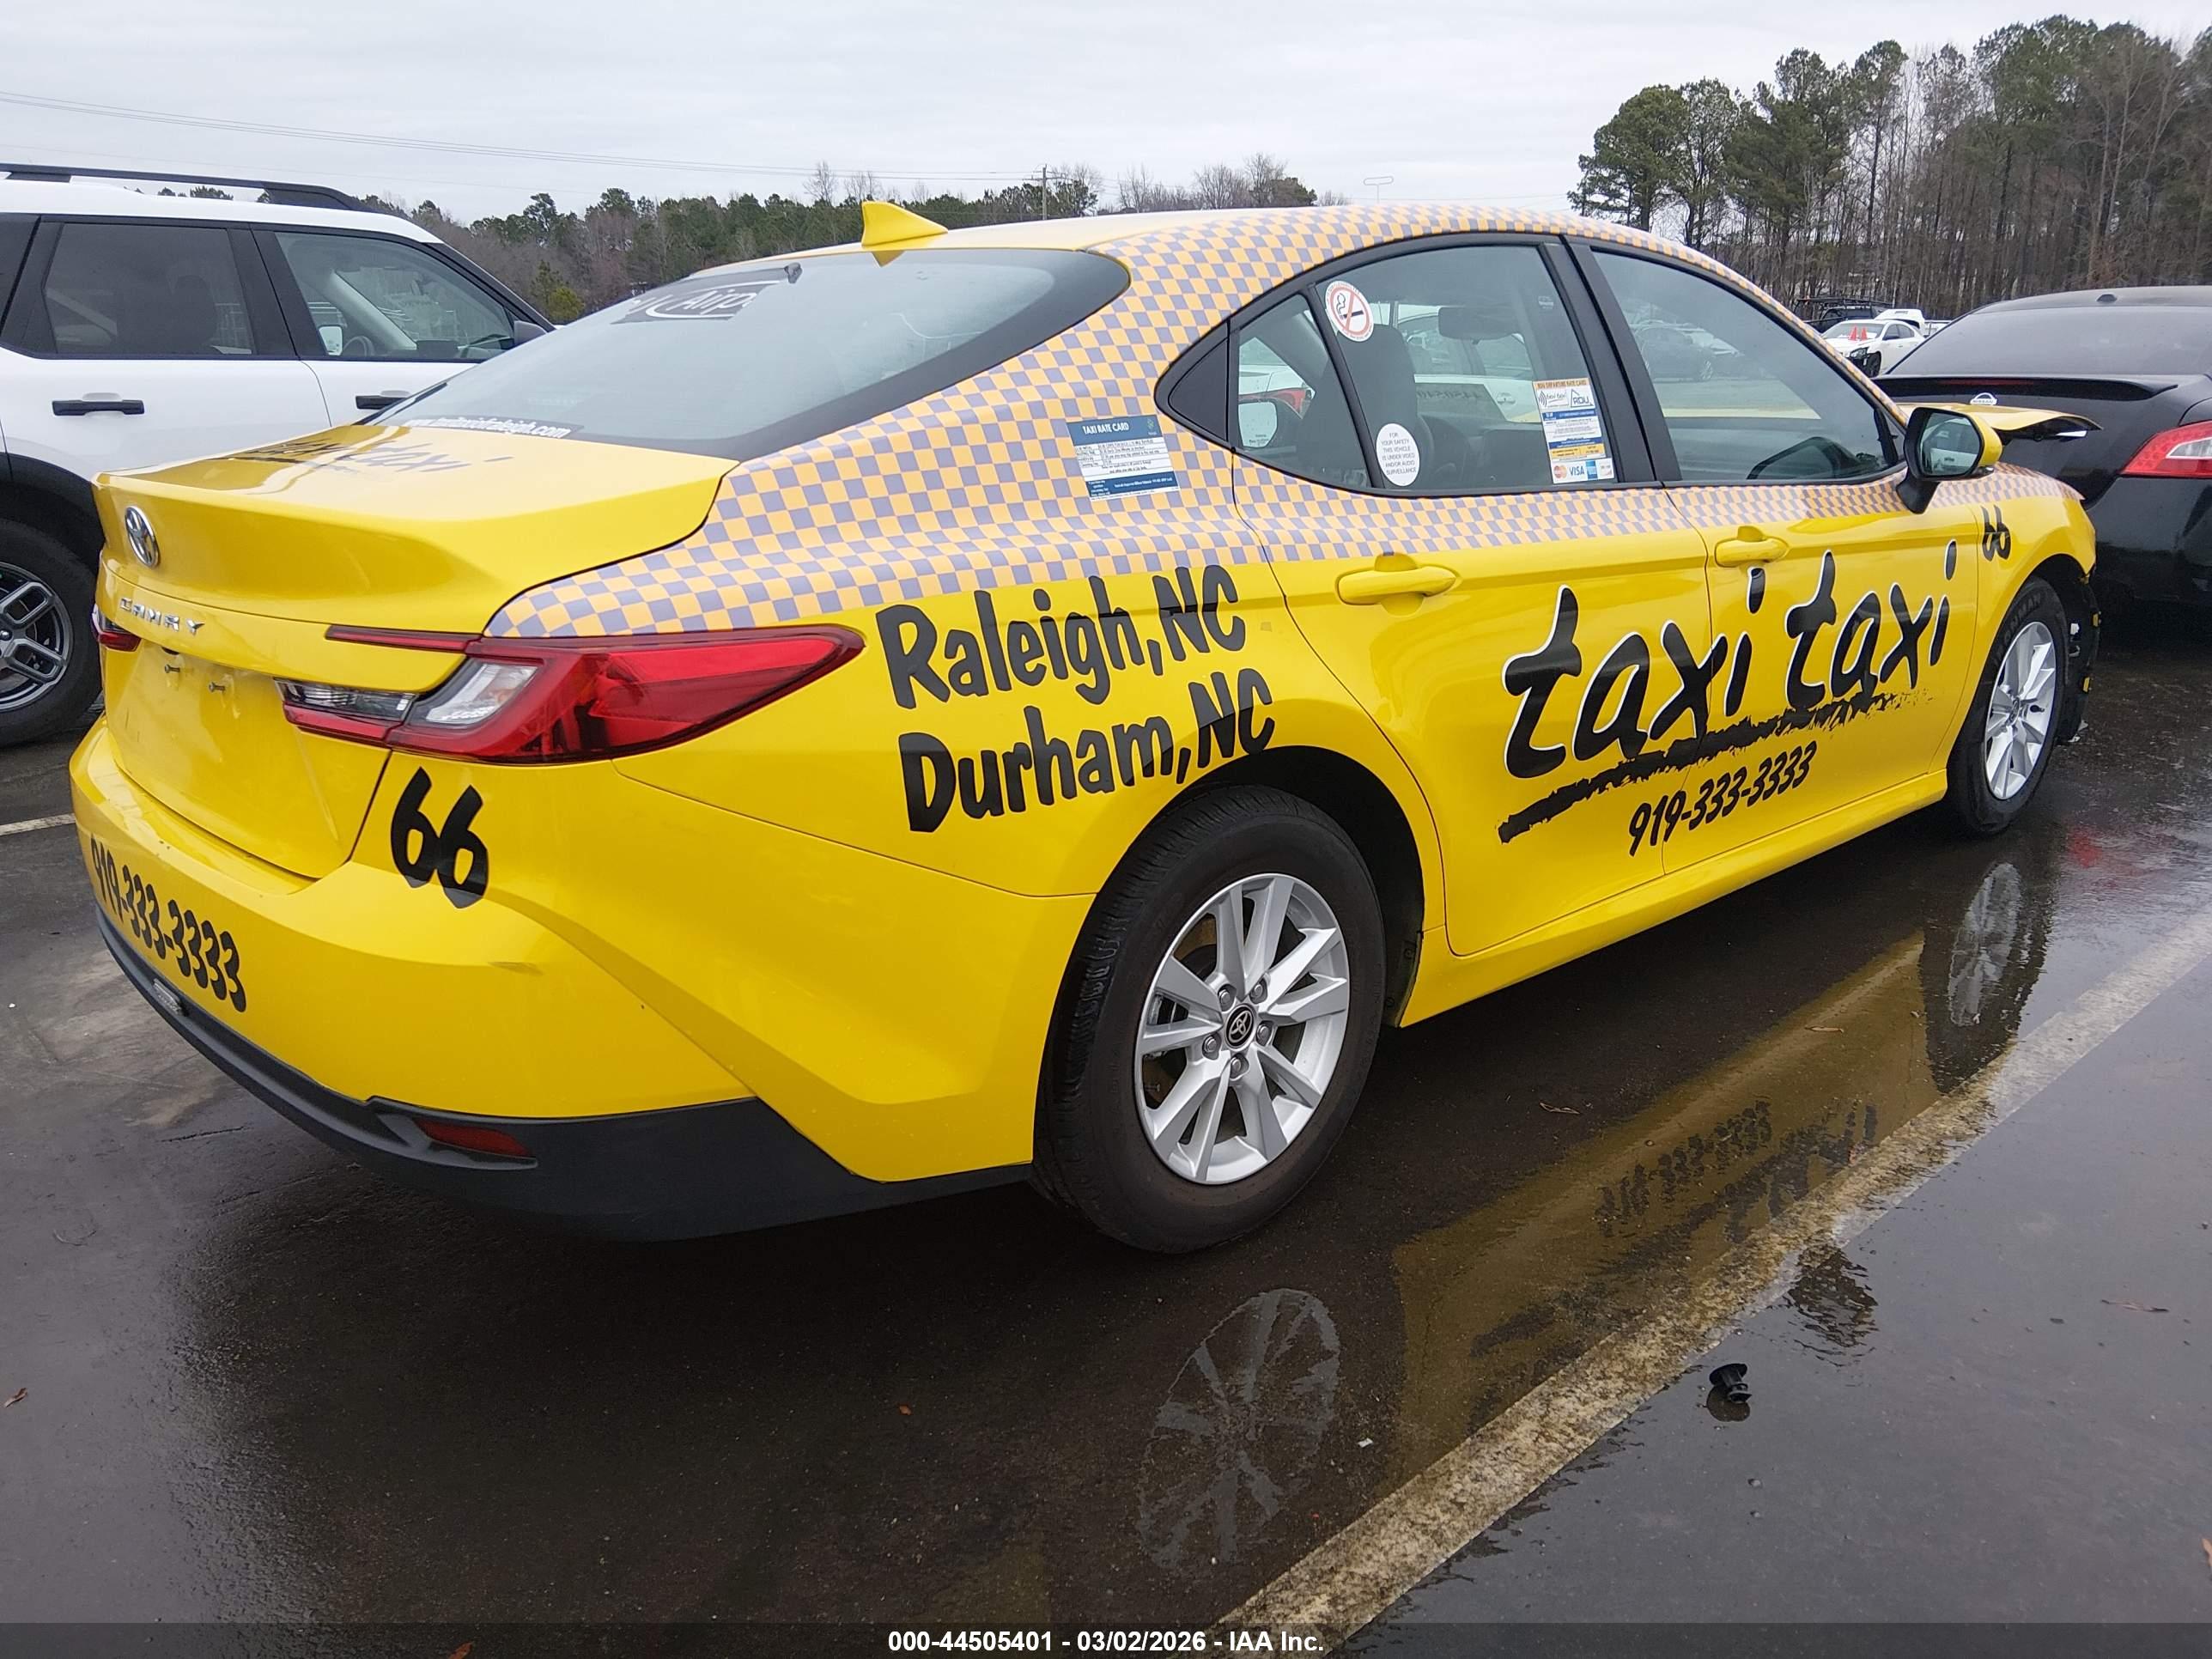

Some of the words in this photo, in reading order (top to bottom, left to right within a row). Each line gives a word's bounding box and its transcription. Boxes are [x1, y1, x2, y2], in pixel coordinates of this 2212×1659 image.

[1082, 425, 1097, 434] TAXI
[1097, 423, 1113, 433] RATE
[1112, 422, 1129, 432] CARD
[1573, 396, 1589, 404] RDU
[1569, 465, 1585, 476] VISA
[1980, 504, 2011, 562] 66
[120, 597, 205, 635] CAMRY
[1502, 567, 1766, 779] taxi
[1785, 539, 1959, 712] taxi
[1629, 740, 1818, 857] 919-333-3333
[391, 766, 489, 908] 66
[90, 833, 246, 1012] 919-333-3333
